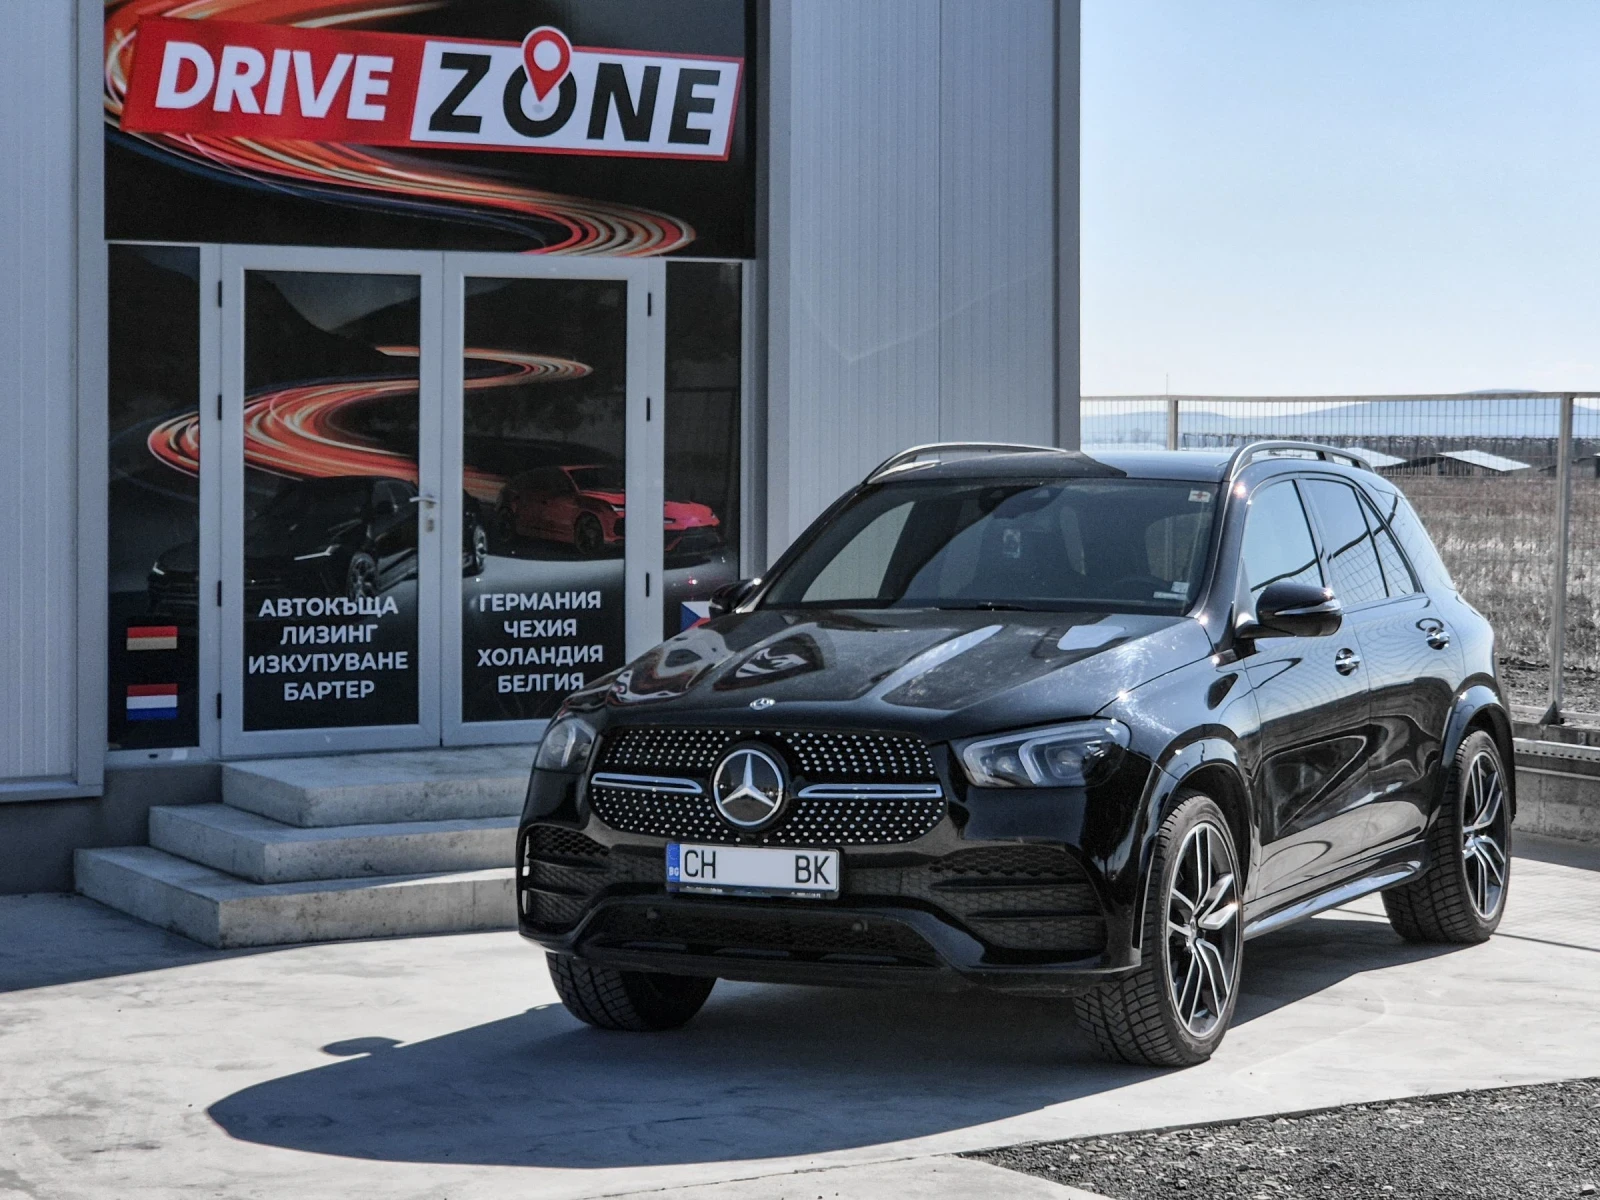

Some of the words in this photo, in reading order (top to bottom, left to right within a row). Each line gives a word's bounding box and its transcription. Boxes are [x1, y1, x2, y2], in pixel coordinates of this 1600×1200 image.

[155, 40, 395, 121] DRIVE
[429, 51, 721, 146] ZONE
[258, 595, 399, 618] АВТОКЪЩА
[479, 591, 601, 612] ГЕРМАНИЯ
[280, 624, 378, 645] ЛИЗИНГ
[504, 618, 577, 638] ЧЕХИЯ
[248, 651, 409, 674] ИЗКУПУВАНЕ
[477, 645, 603, 668] ХОЛАНДИЯ
[283, 681, 375, 701] БАРТЕР
[498, 672, 584, 693] БЕЛГИЯ
[668, 866, 680, 877] BG
[684, 849, 717, 879] CH
[794, 854, 830, 885] BK
